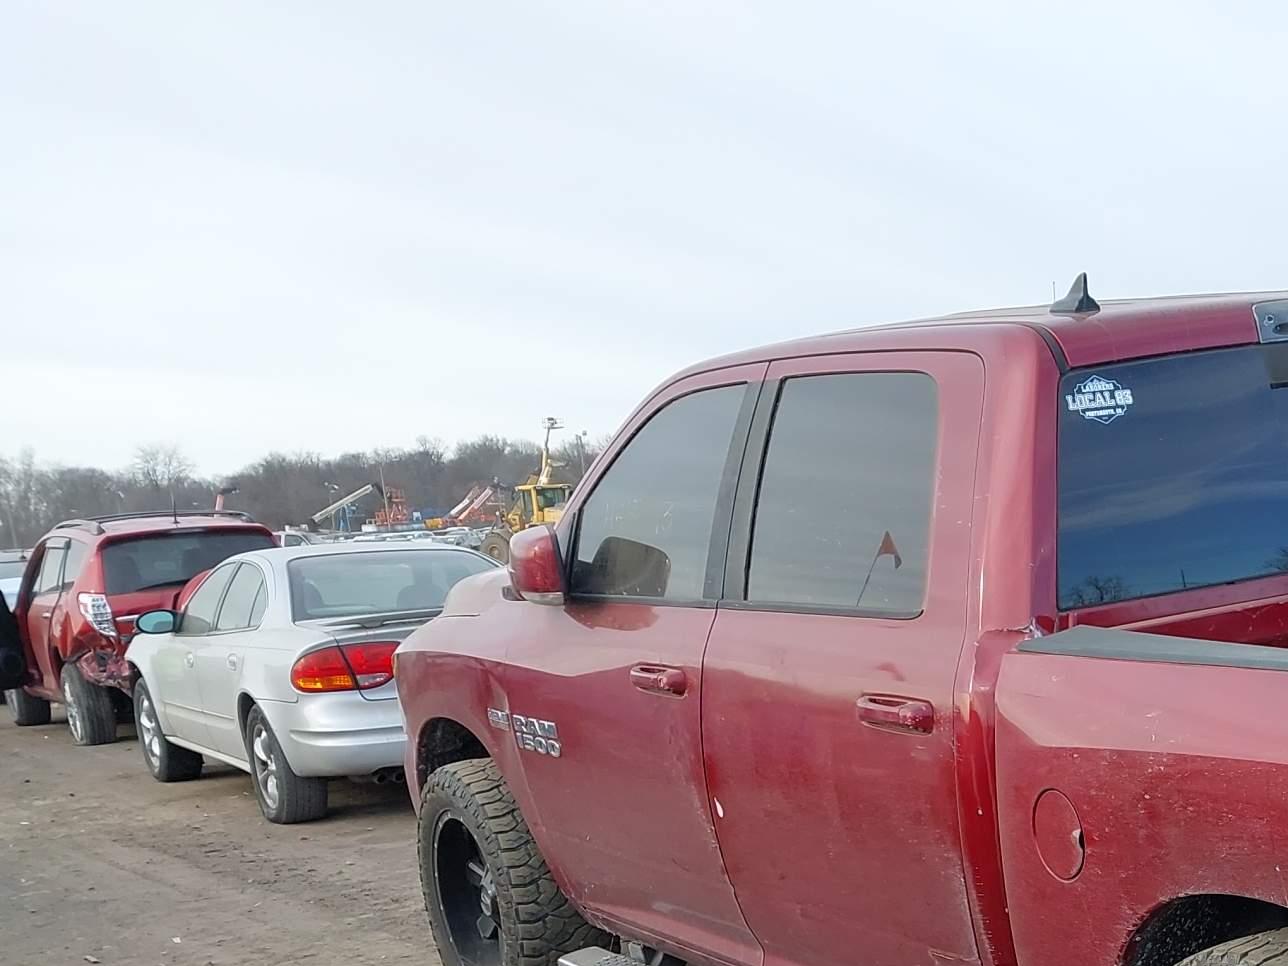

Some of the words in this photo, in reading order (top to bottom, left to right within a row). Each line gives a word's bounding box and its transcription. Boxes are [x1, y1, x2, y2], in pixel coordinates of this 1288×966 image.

[1065, 390, 1116, 411] LOCAL
[512, 714, 558, 739] RAM
[515, 731, 561, 758] 1500
